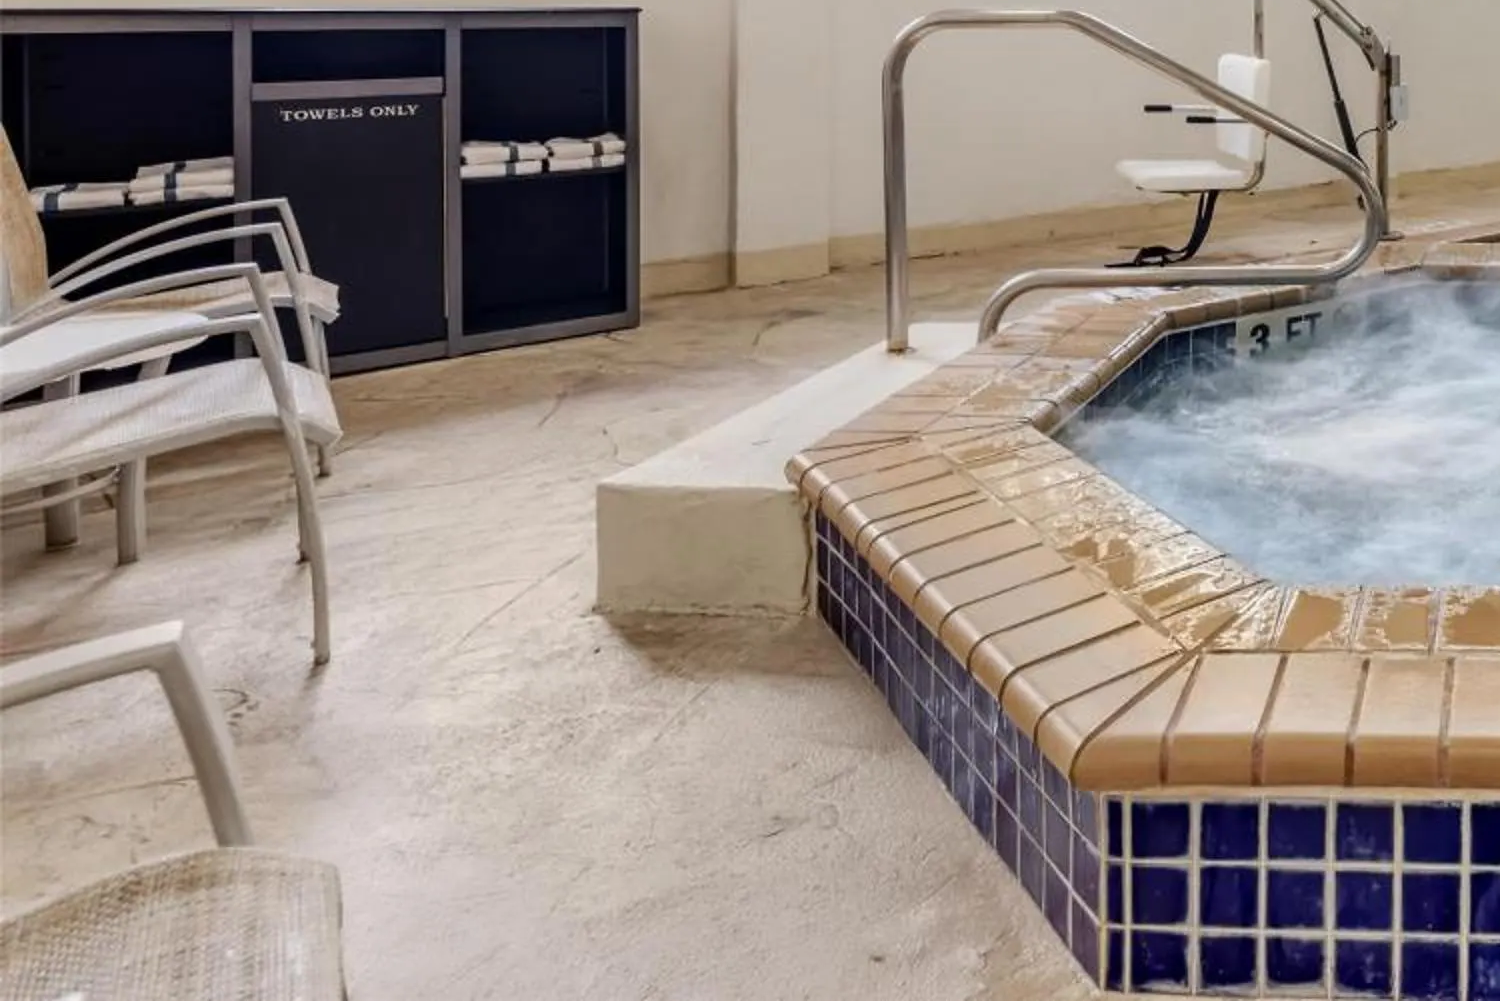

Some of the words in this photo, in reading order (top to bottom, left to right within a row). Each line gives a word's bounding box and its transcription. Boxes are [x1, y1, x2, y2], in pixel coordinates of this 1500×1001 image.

[280, 107, 364, 122] TOWELS
[369, 105, 418, 118] ONLY
[1250, 322, 1270, 357] 3
[1286, 311, 1322, 342] FT
